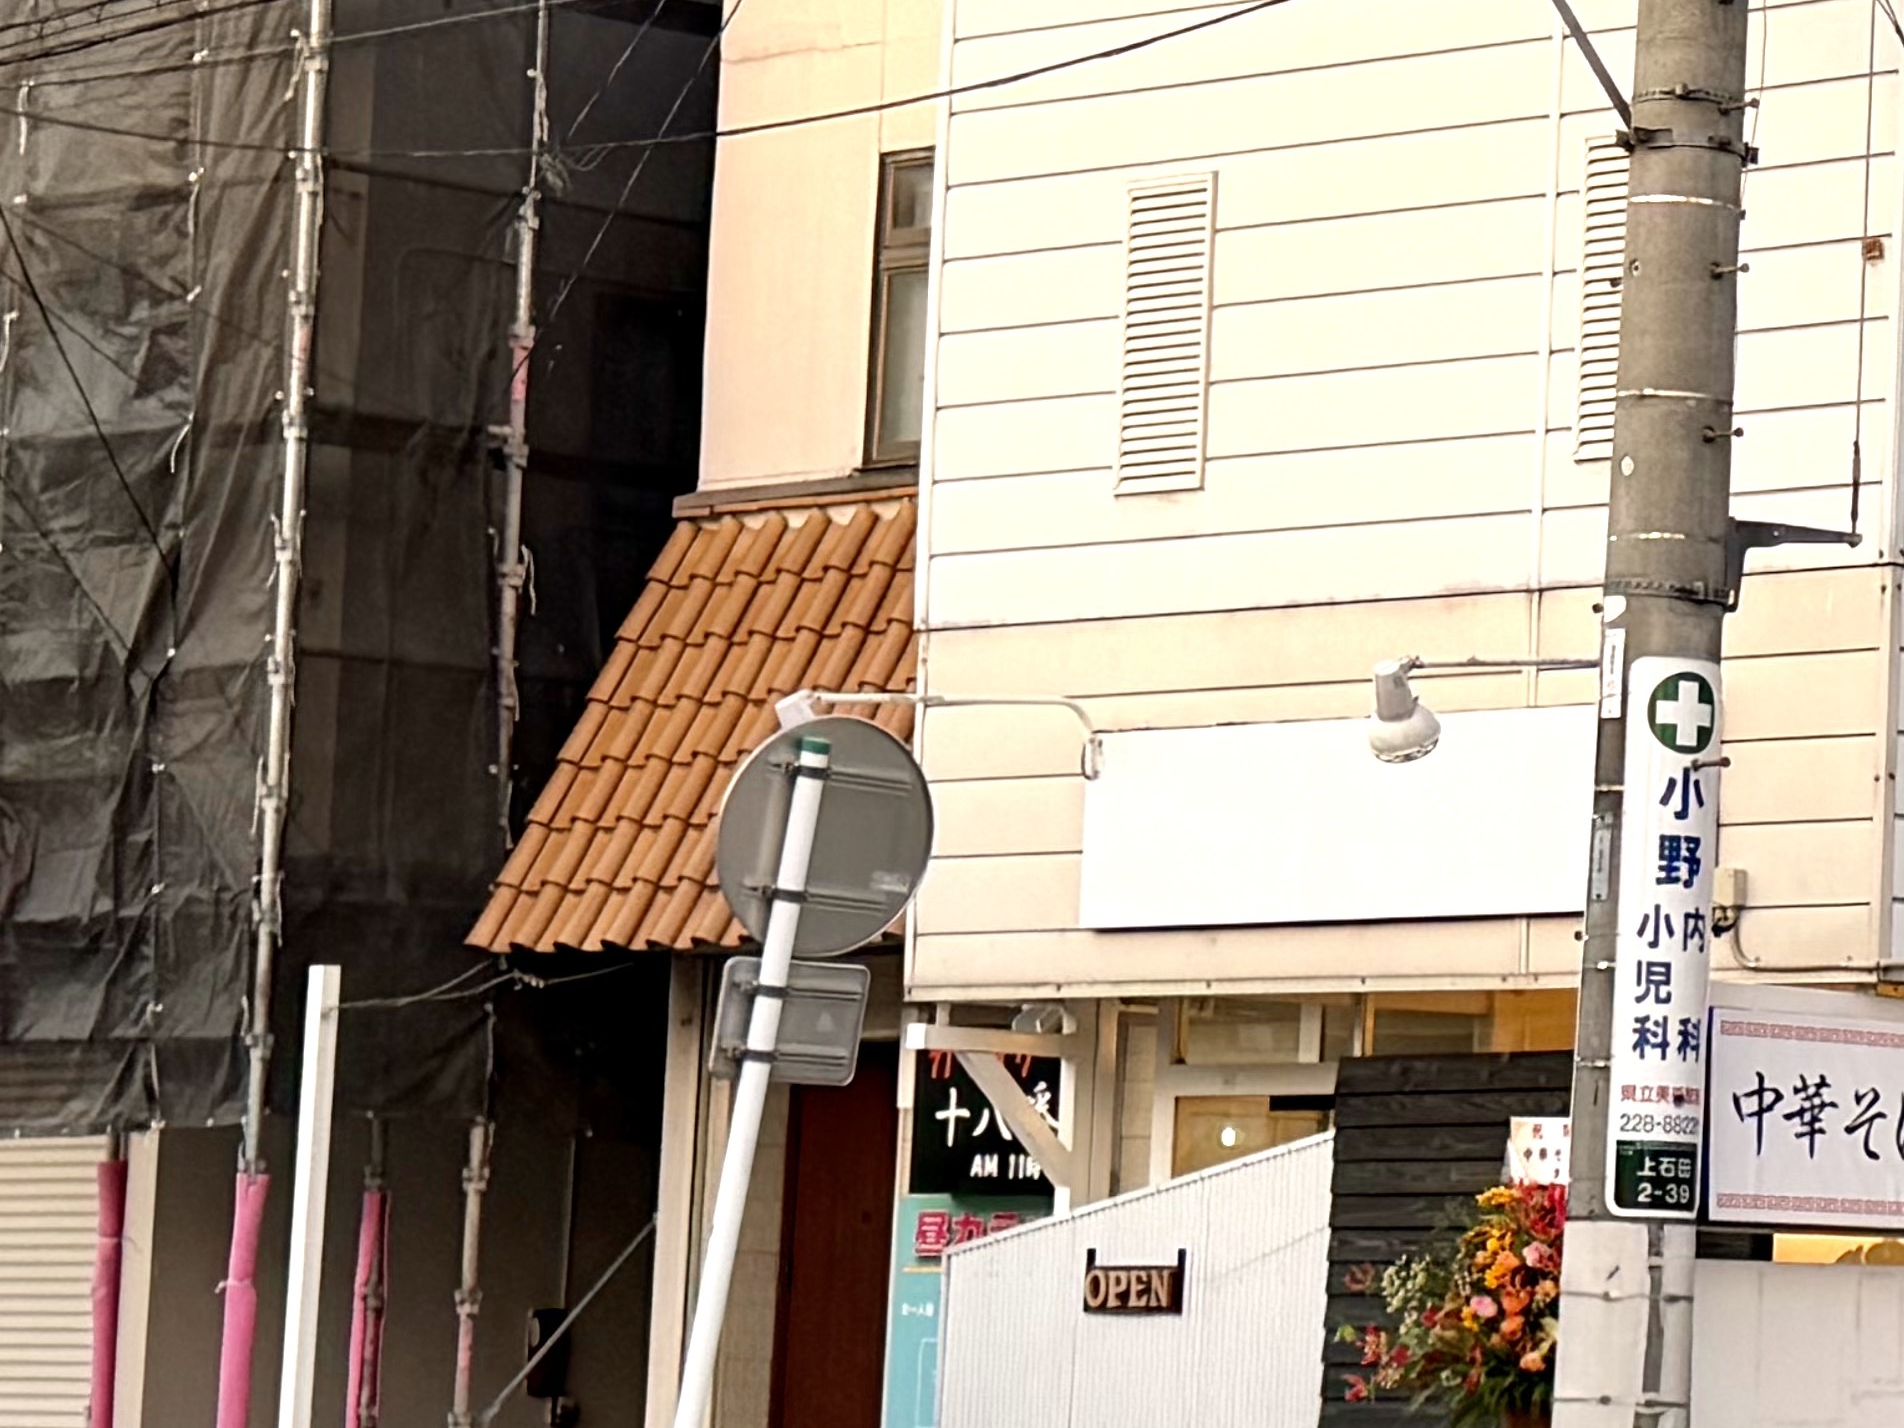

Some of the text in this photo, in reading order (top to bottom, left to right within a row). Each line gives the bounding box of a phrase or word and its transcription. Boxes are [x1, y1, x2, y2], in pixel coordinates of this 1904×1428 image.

[1632, 904, 1676, 1061] 小児科
[969, 1153, 999, 1178] AM
[1636, 1156, 1692, 1179] 上石田
[1637, 1182, 1690, 1204] 2-39
[1085, 1269, 1171, 1308] OPEN
